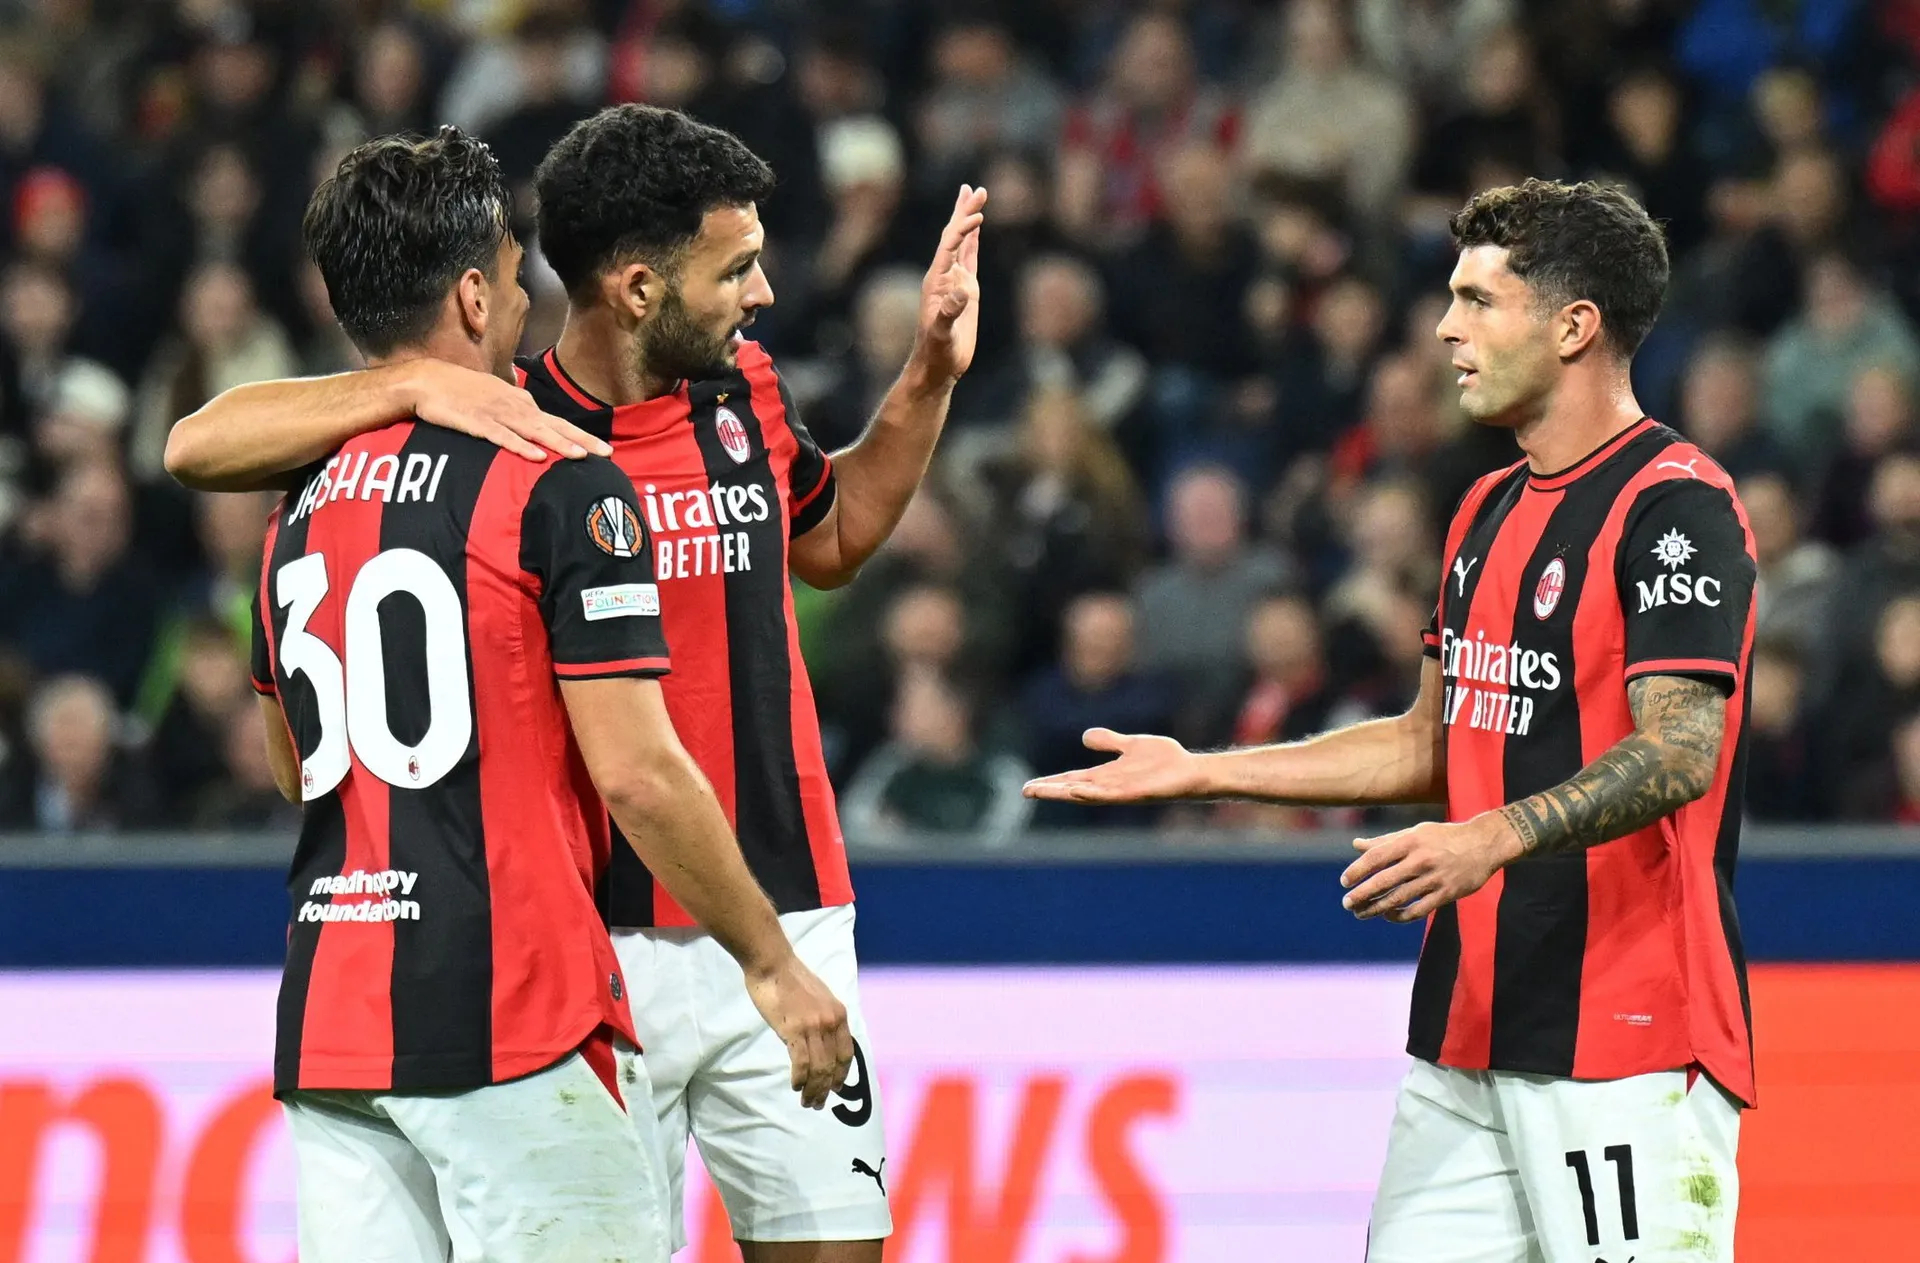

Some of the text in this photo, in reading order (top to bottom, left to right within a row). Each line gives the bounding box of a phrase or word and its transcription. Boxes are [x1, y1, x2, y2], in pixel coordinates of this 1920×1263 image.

[288, 451, 449, 526] JASHARI
[644, 480, 769, 533] irates
[657, 532, 751, 580] BETTER
[1636, 573, 1721, 613] MSC
[276, 547, 472, 802] 30
[1442, 628, 1561, 690] Emirates
[1470, 689, 1534, 736] BETTER
[831, 1035, 872, 1127] 9
[1565, 1144, 1639, 1246] 11
